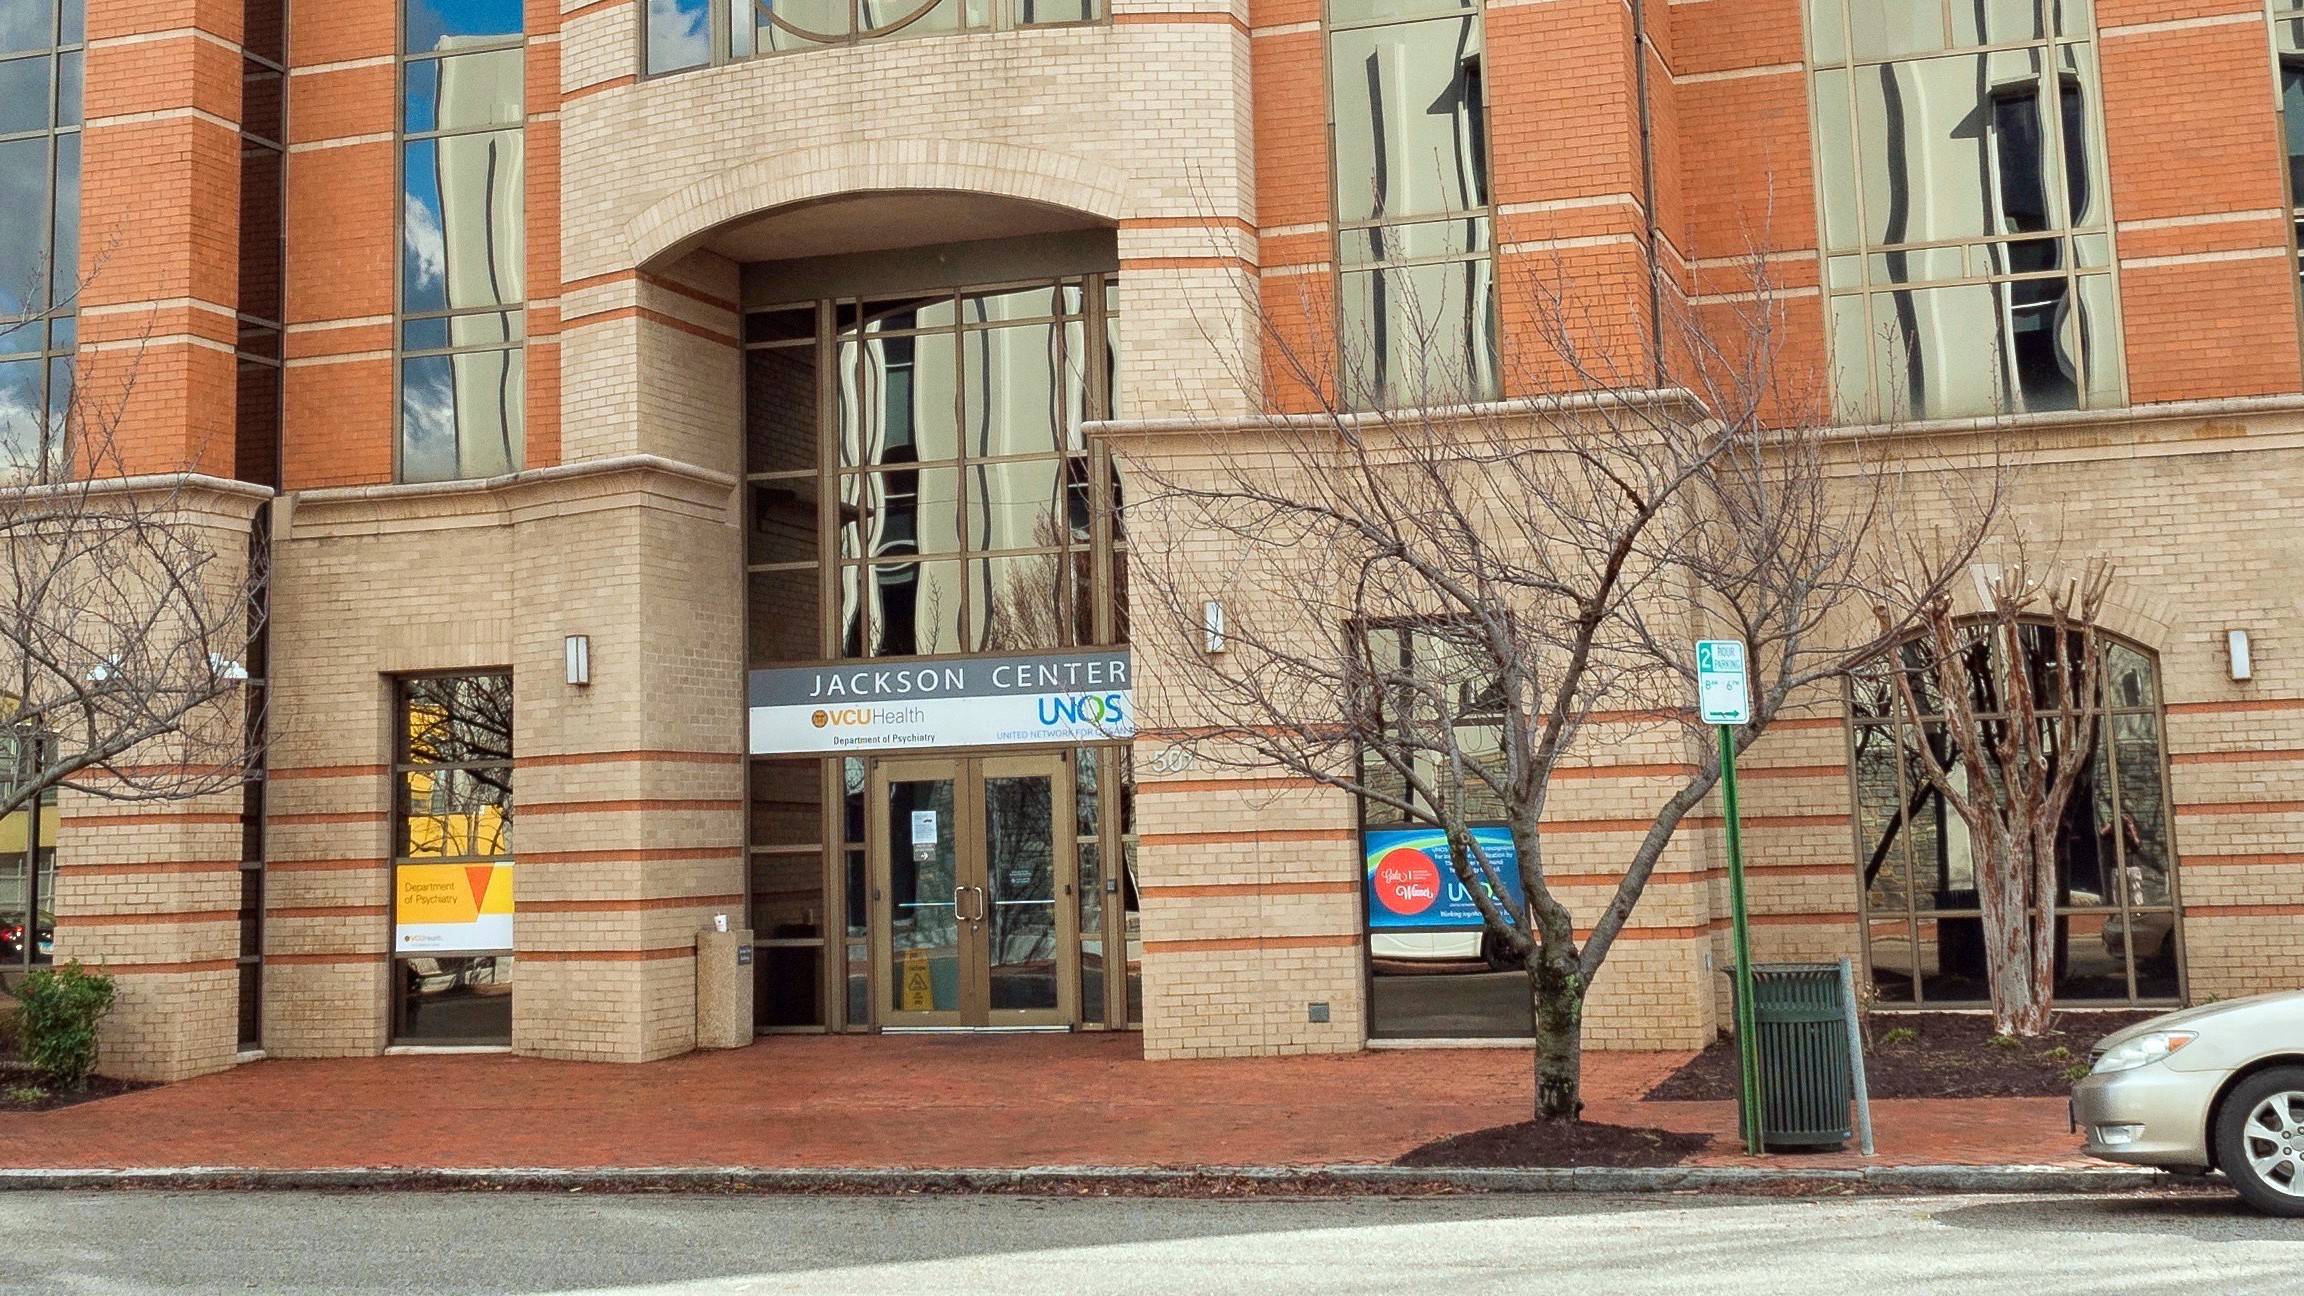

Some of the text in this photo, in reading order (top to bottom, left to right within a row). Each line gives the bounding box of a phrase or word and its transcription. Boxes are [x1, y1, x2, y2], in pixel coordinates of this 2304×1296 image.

[1700, 648, 1711, 669] 2
[810, 660, 1126, 697] JACKSON CENTER
[1038, 694, 1123, 726] UNOS
[833, 733, 935, 747] Department of Psychiatry
[996, 730, 1029, 740] UNITED
[1030, 729, 1073, 739] NETWORK
[404, 882, 456, 893] Department
[404, 894, 458, 905] of Psychiatry
